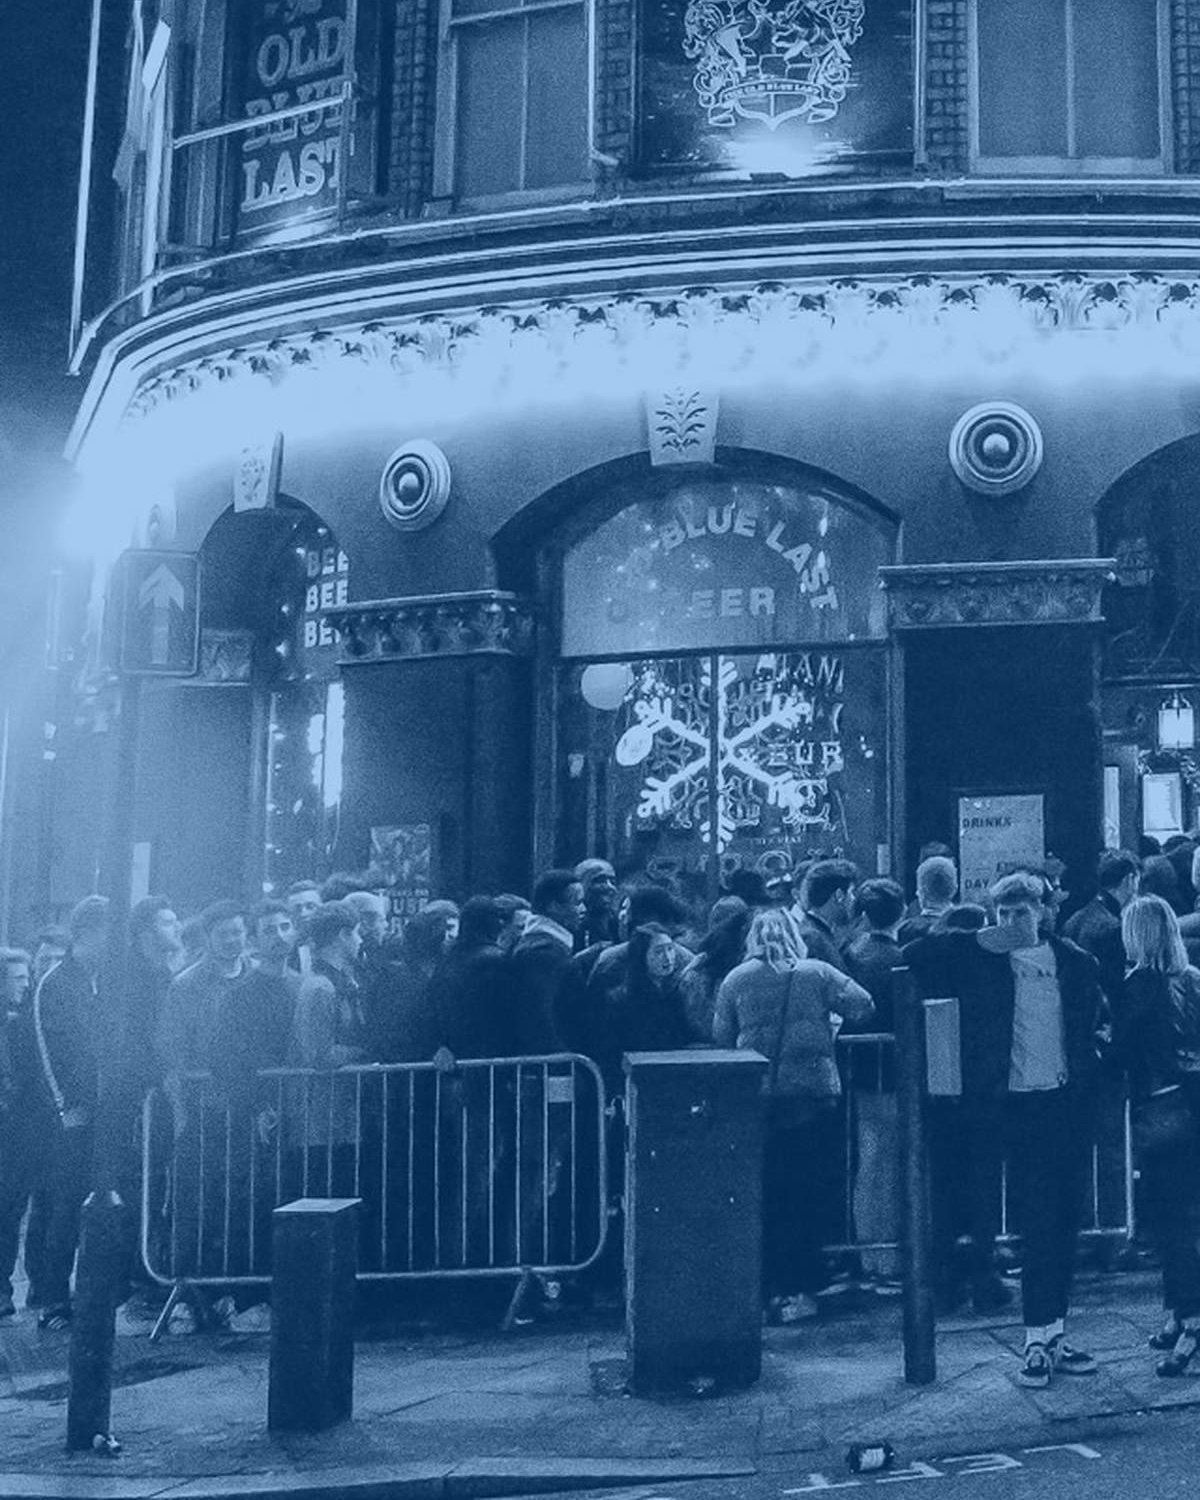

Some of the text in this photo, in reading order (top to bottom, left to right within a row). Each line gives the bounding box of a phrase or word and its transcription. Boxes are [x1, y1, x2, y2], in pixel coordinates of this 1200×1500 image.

[256, 16, 350, 87] OLD
[240, 132, 355, 213] LAST
[659, 503, 839, 611] BLUE LAST
